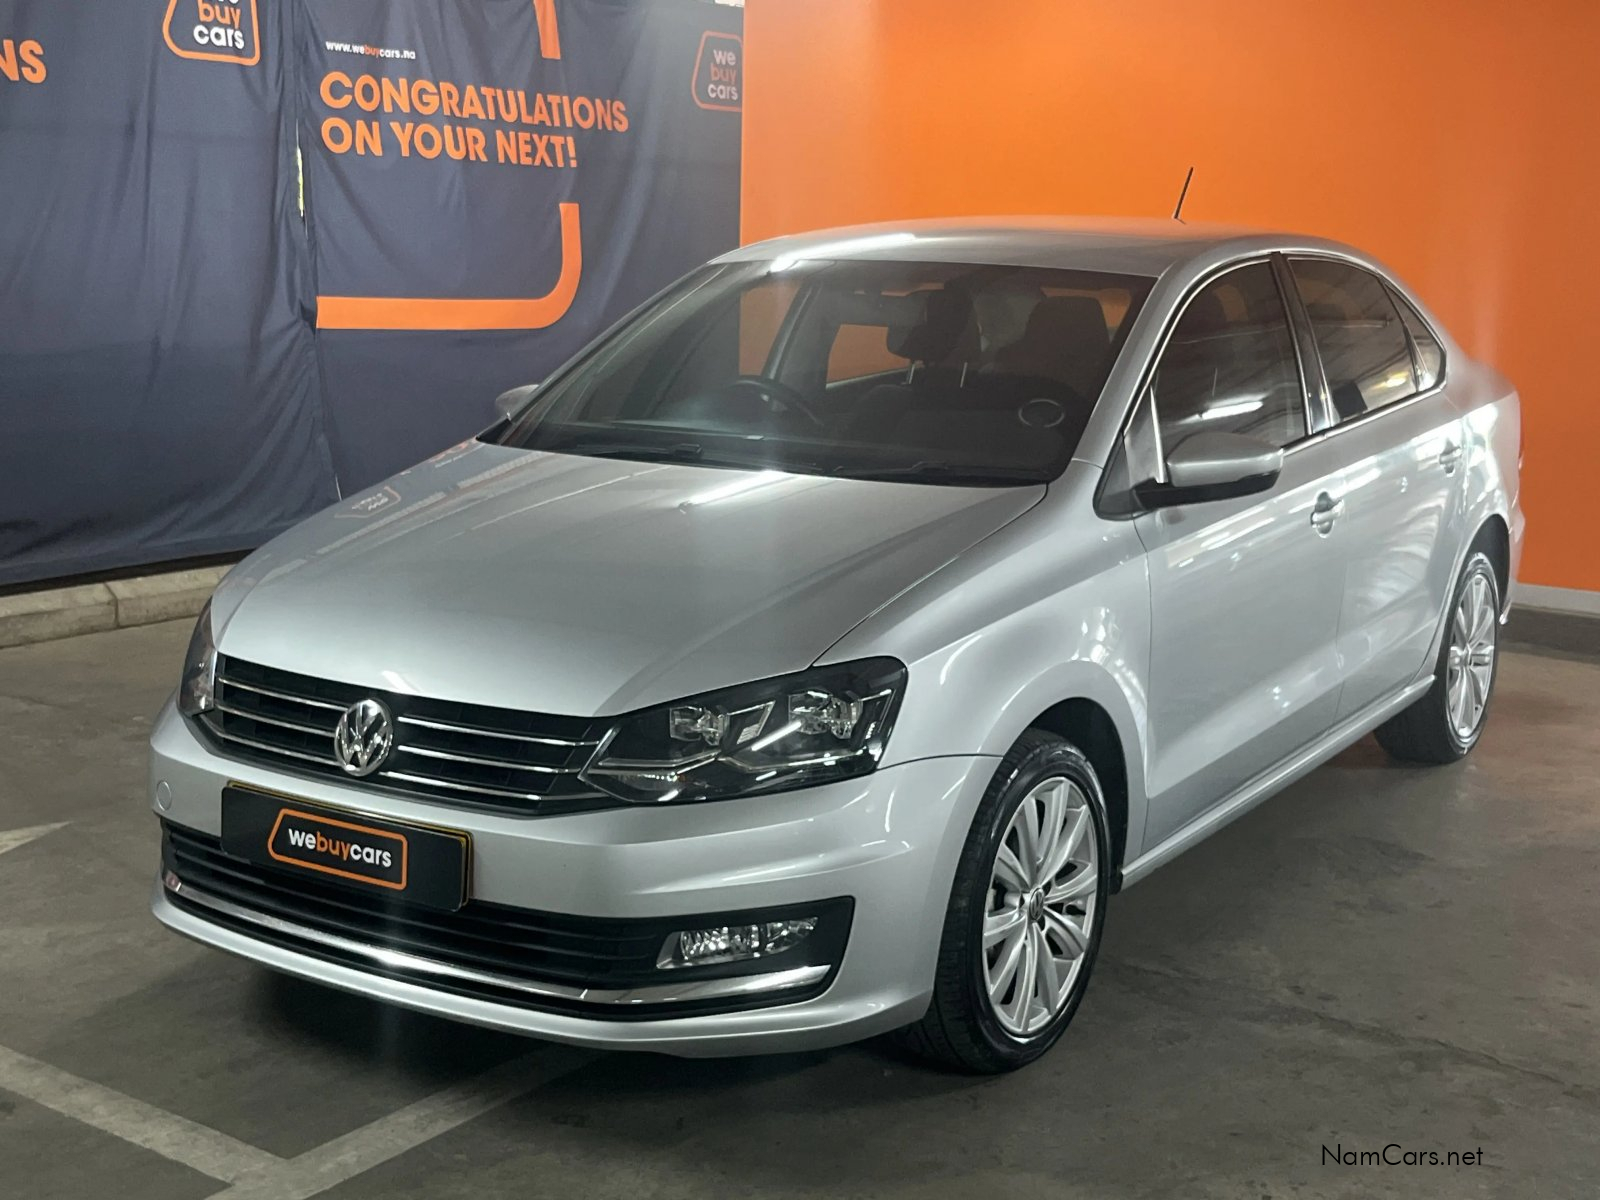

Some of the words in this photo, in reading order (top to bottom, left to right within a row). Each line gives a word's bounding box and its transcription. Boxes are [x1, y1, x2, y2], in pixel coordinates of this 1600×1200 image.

[197, 0, 241, 29] buy
[193, 25, 245, 49] cars
[325, 41, 416, 60] www.webuycars.na
[713, 49, 737, 66] we
[710, 62, 737, 85] buy
[320, 71, 629, 132] CONGRATULATIONS
[707, 83, 738, 101] cars
[321, 117, 383, 157] ON
[389, 121, 488, 162] YOUR
[495, 129, 577, 168] NEXT!
[288, 828, 392, 868] webuycars
